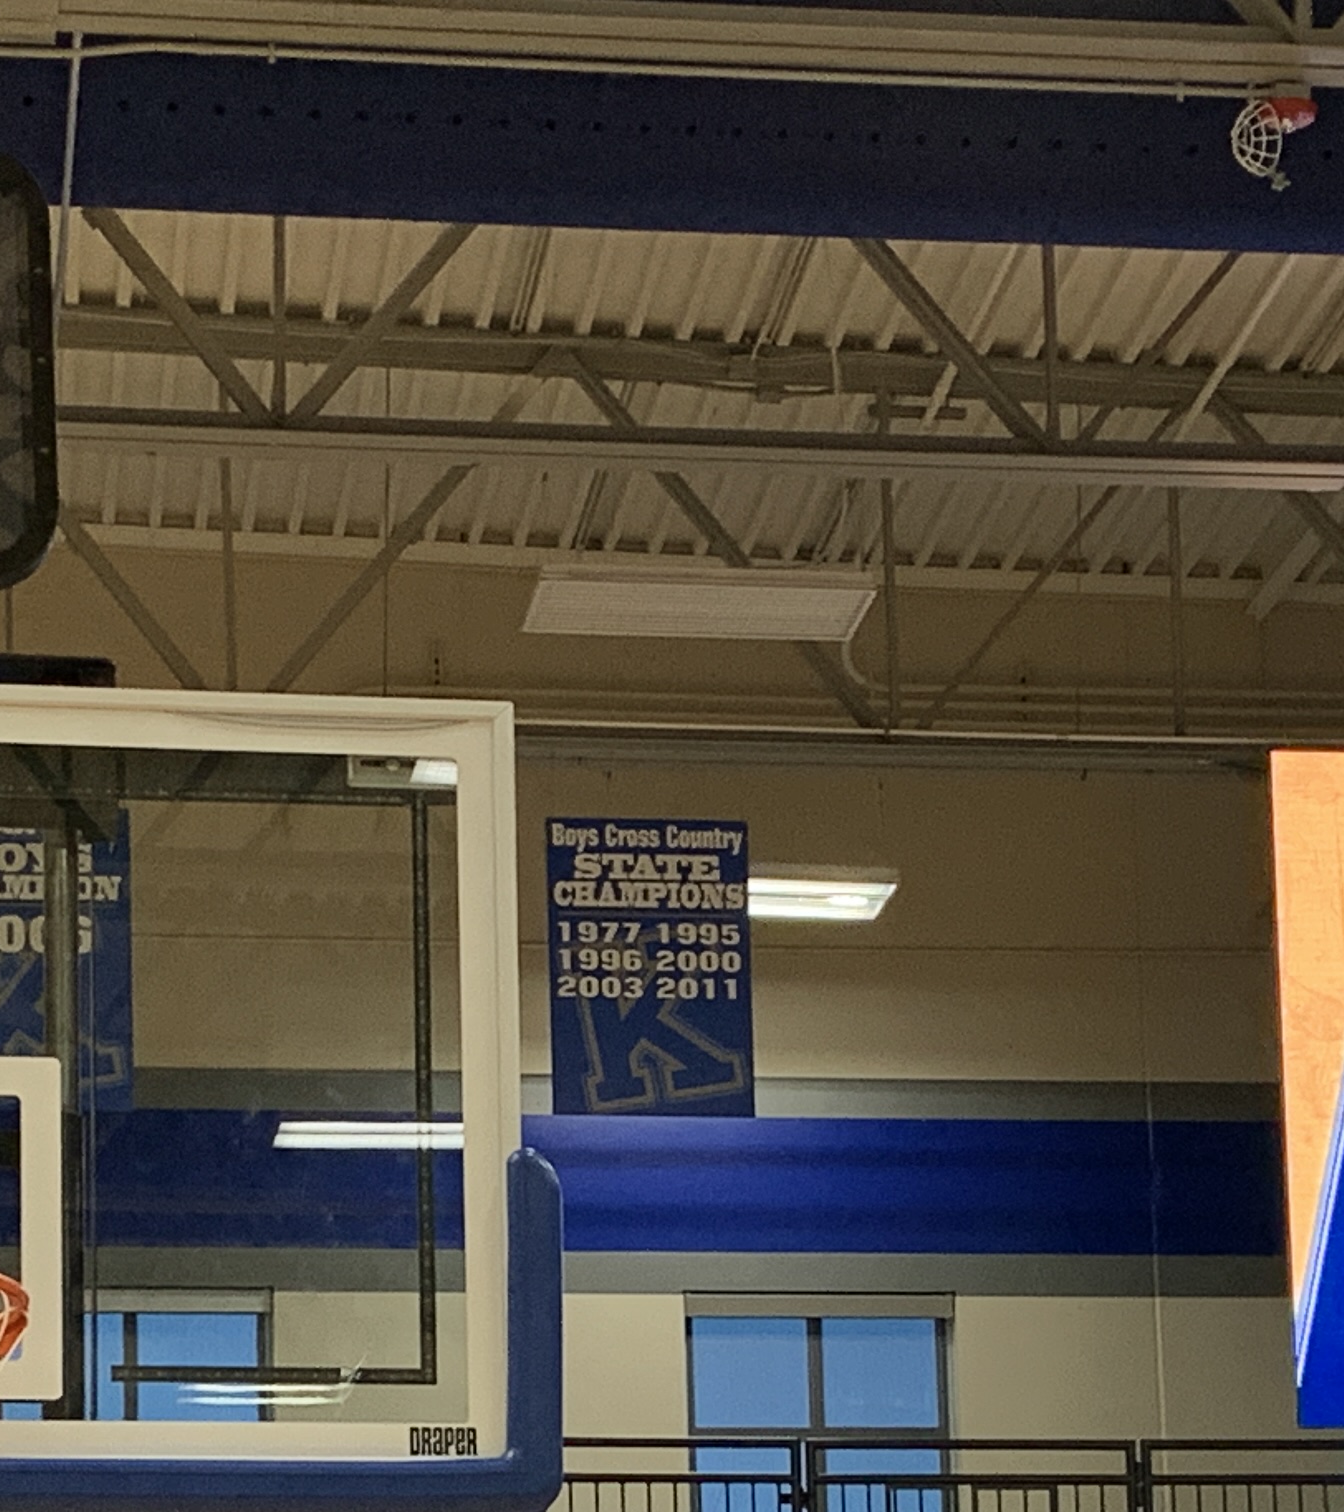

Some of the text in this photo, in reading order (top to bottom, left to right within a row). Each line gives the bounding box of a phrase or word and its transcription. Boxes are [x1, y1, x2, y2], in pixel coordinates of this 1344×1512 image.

[551, 822, 743, 855] Boys Cross Country
[573, 853, 721, 881] STATE
[553, 881, 746, 910] CHAMPIONS
[558, 921, 741, 945] 1977 1995
[558, 949, 742, 973] 1996 2000
[557, 975, 738, 1000] 2003 2011
